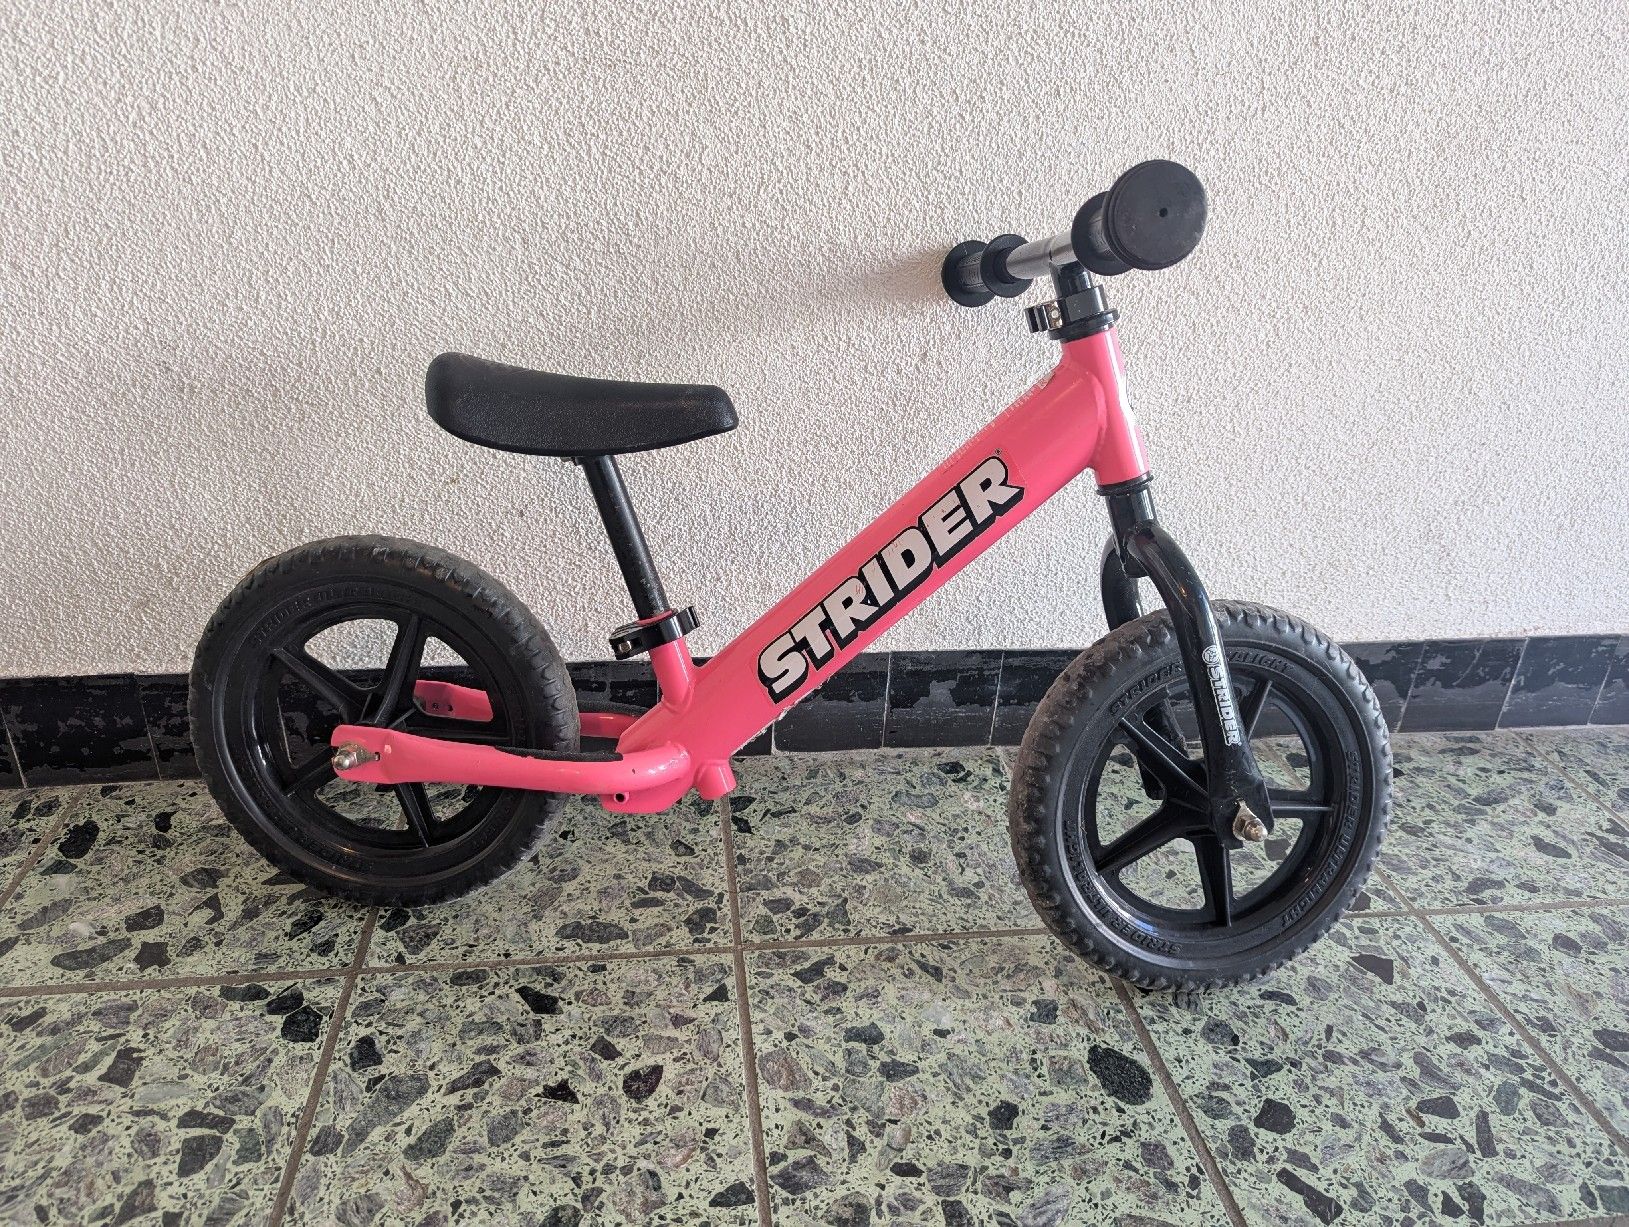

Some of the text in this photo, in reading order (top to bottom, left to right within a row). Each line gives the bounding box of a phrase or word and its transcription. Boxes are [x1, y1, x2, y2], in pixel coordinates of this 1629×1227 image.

[757, 455, 1025, 704] STRIDER
[1227, 650, 1293, 676] ALIGHT
[1207, 666, 1241, 747] STRIDER
